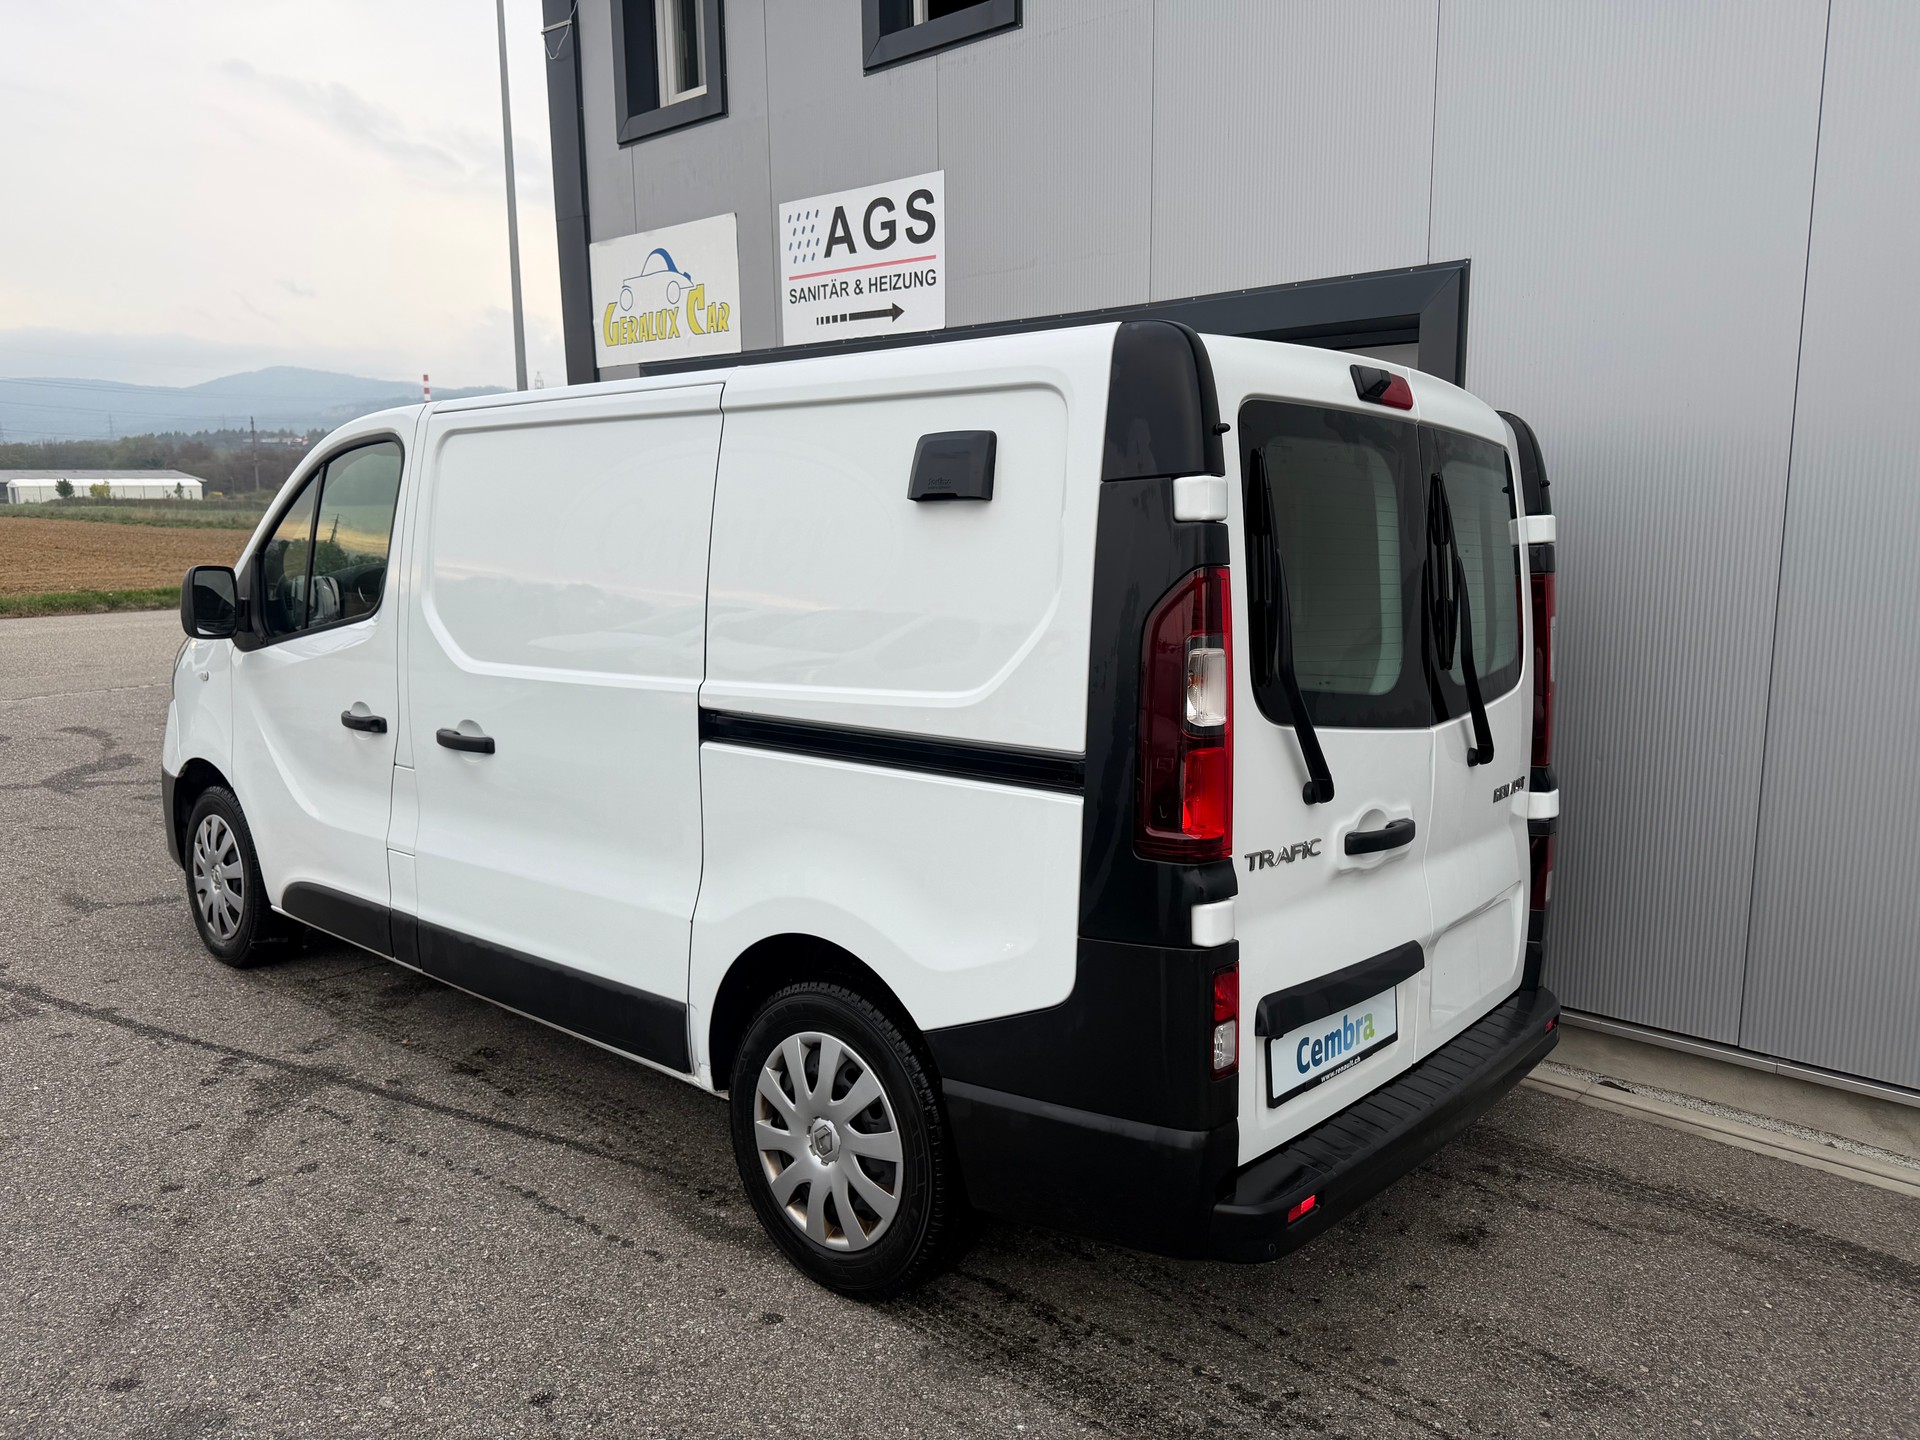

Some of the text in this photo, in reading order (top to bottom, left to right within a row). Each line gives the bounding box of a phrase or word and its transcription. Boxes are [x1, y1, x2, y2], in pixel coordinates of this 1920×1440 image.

[824, 188, 936, 259] AGS
[789, 268, 937, 305] SANITÄR & HEIZUNG
[1243, 837, 1322, 872] TRAFIC
[1296, 1012, 1375, 1075] Cembra
